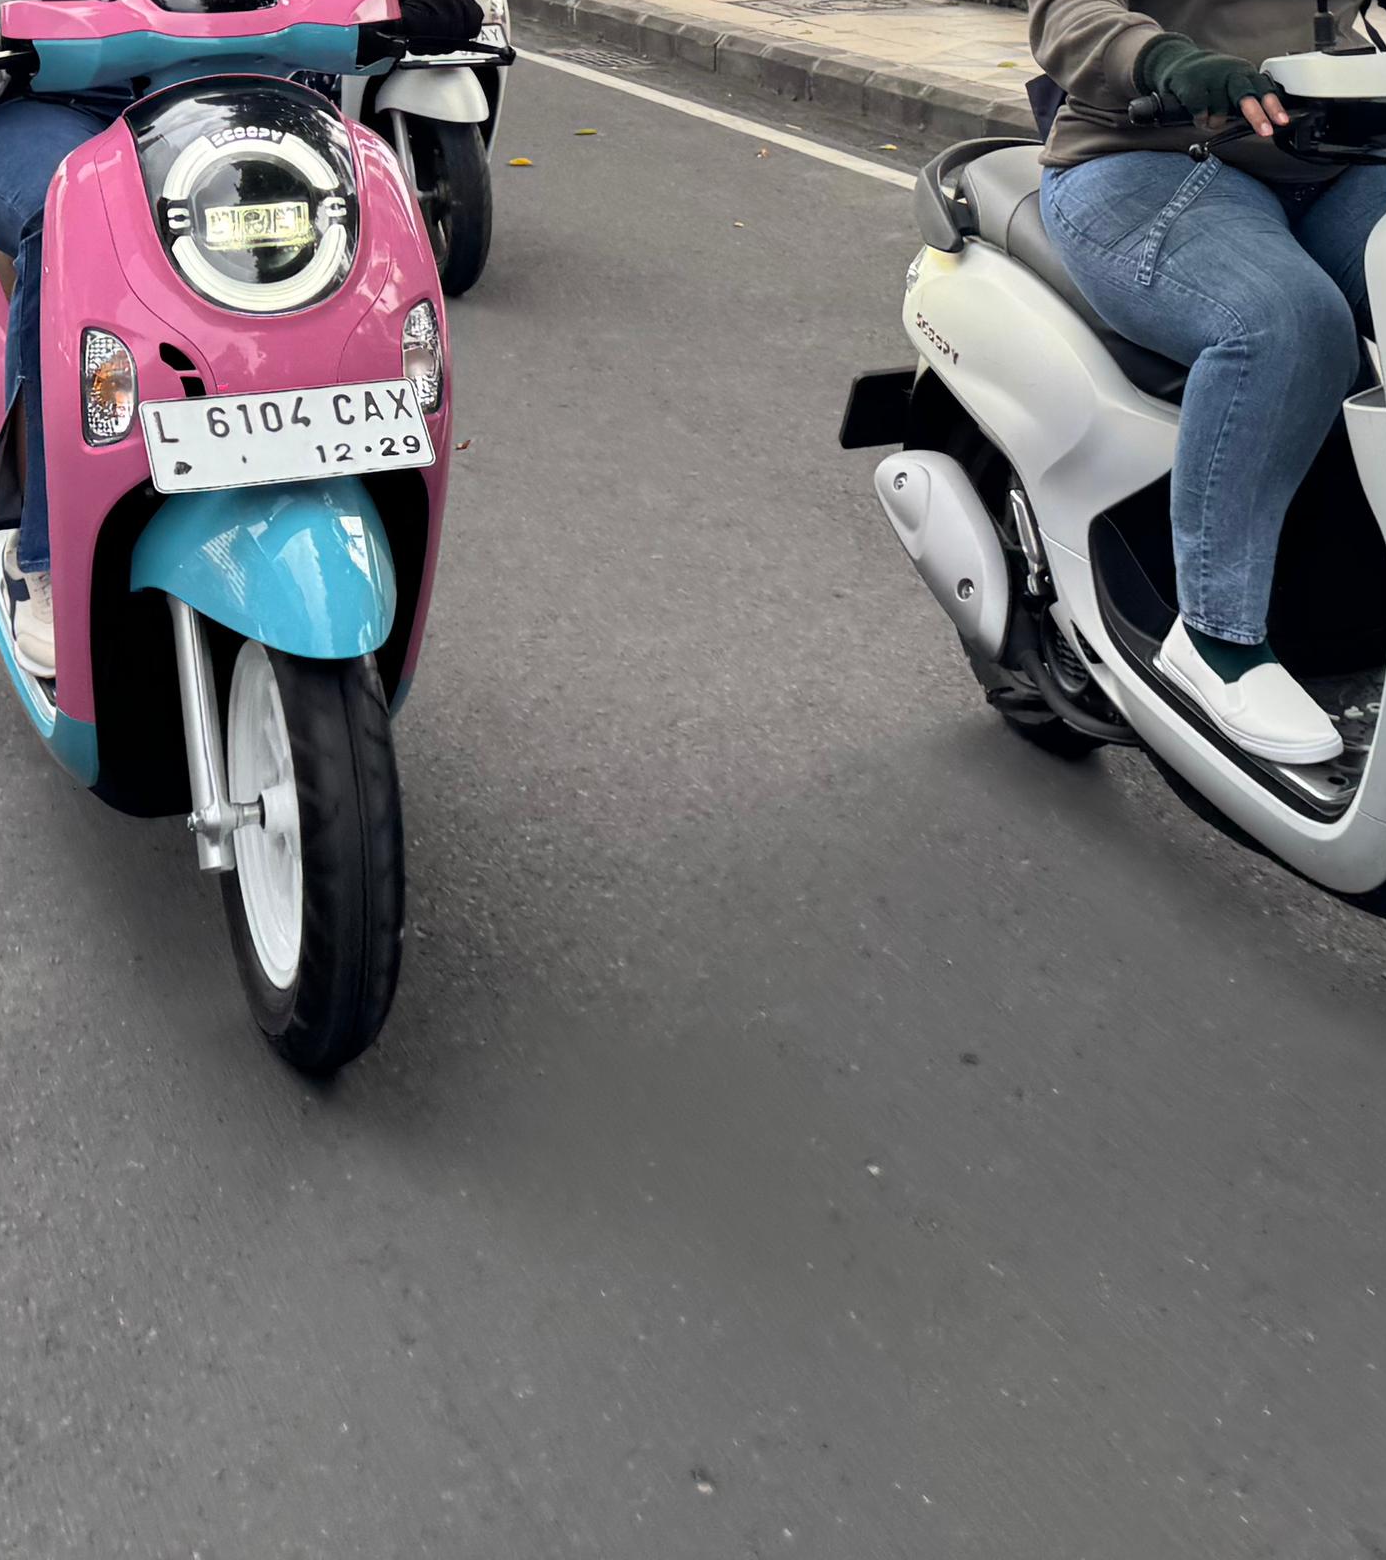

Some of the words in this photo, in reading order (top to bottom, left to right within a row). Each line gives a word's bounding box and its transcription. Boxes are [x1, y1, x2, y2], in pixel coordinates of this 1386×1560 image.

[211, 125, 283, 147] SCOOPY
[916, 311, 959, 366] SCOOPY
[153, 410, 180, 444] L
[206, 396, 312, 439] 6104
[332, 388, 414, 426] CAX
